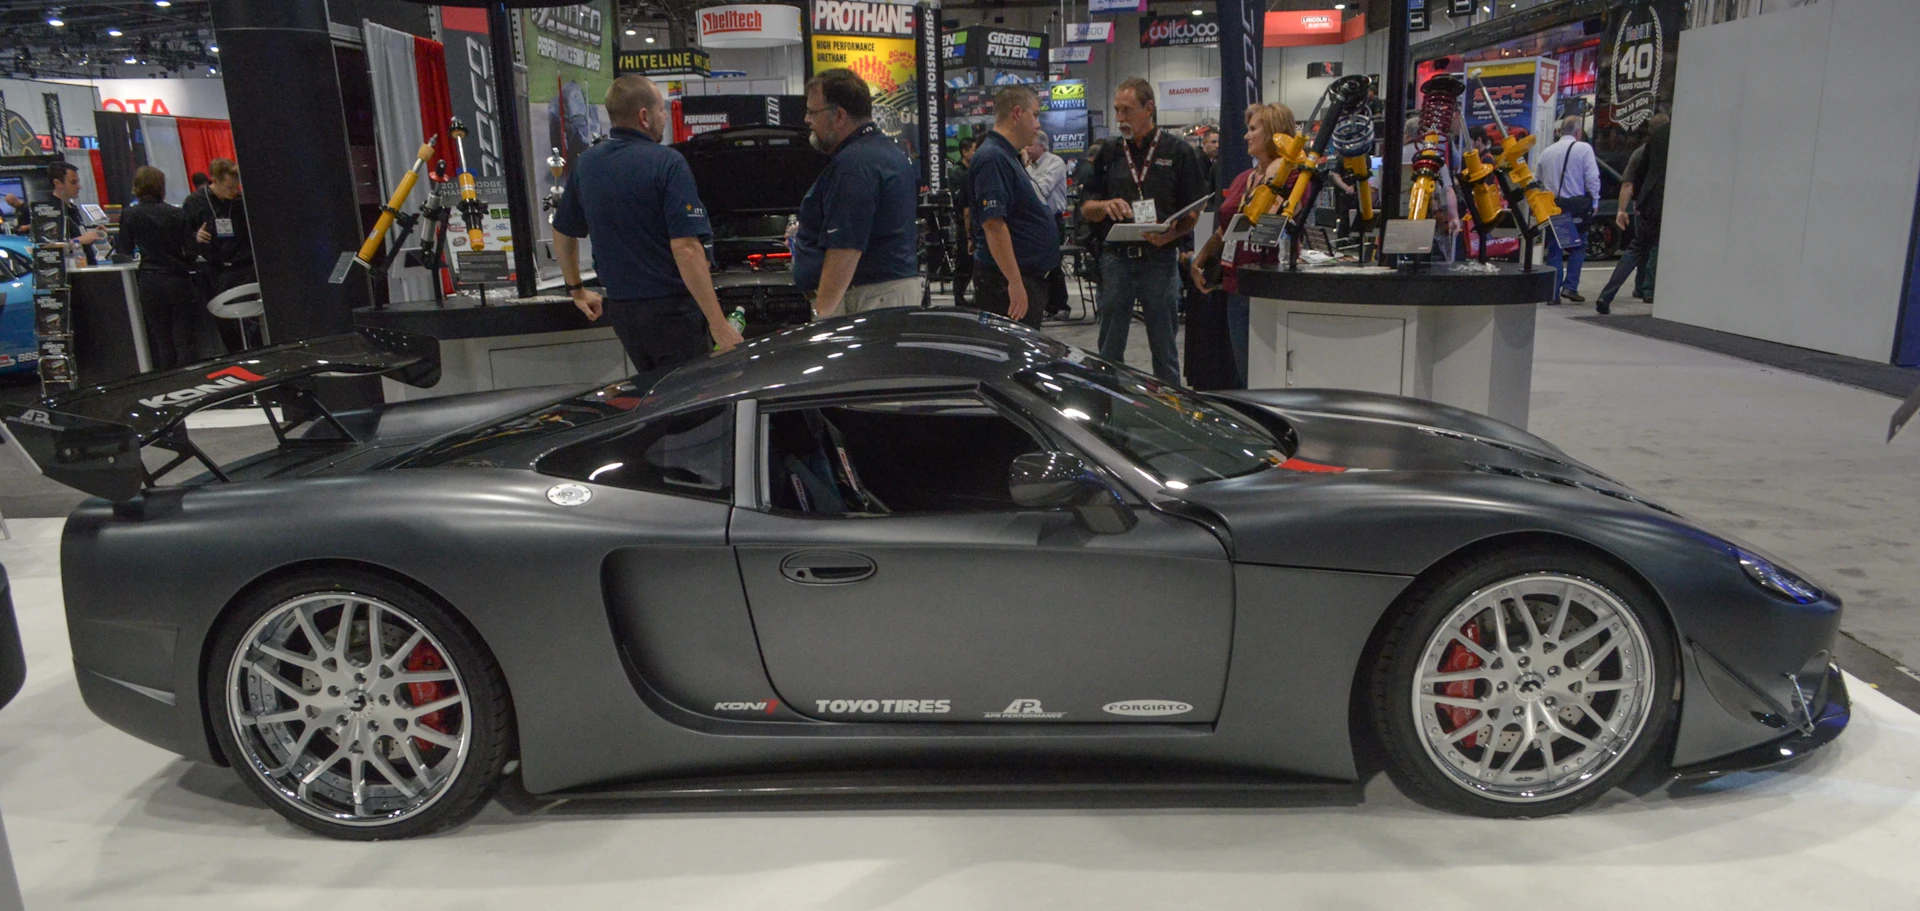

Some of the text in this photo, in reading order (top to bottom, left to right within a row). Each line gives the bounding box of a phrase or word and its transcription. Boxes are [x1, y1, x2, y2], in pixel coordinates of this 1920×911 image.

[712, 10, 761, 30] belltech
[814, 1, 913, 34] PROTHANE
[1074, 26, 1103, 36] 24600
[1150, 20, 1220, 39] wilwoo
[988, 32, 1030, 46] GREEN
[816, 41, 875, 52] HIGH PERFORMANCE
[987, 44, 1029, 58] FILTER
[817, 53, 847, 63] URETHANE
[1060, 50, 1084, 59] 24700
[1619, 43, 1654, 80] 40
[1168, 87, 1209, 96] MAGNUSON
[1618, 81, 1650, 91] YEARS YOUNG
[925, 14, 939, 195] SUSPENSION TRANS MOUNTS
[684, 113, 727, 123] PERFORMANCE
[1053, 133, 1085, 141] VENT
[1053, 141, 1085, 151] SPECIALTY
[18, 352, 39, 363] BBS
[139, 376, 247, 408] KONI
[714, 702, 766, 711] KONI
[816, 699, 950, 713] TOYO TIRES
[1109, 703, 1187, 711] FORGIATO
